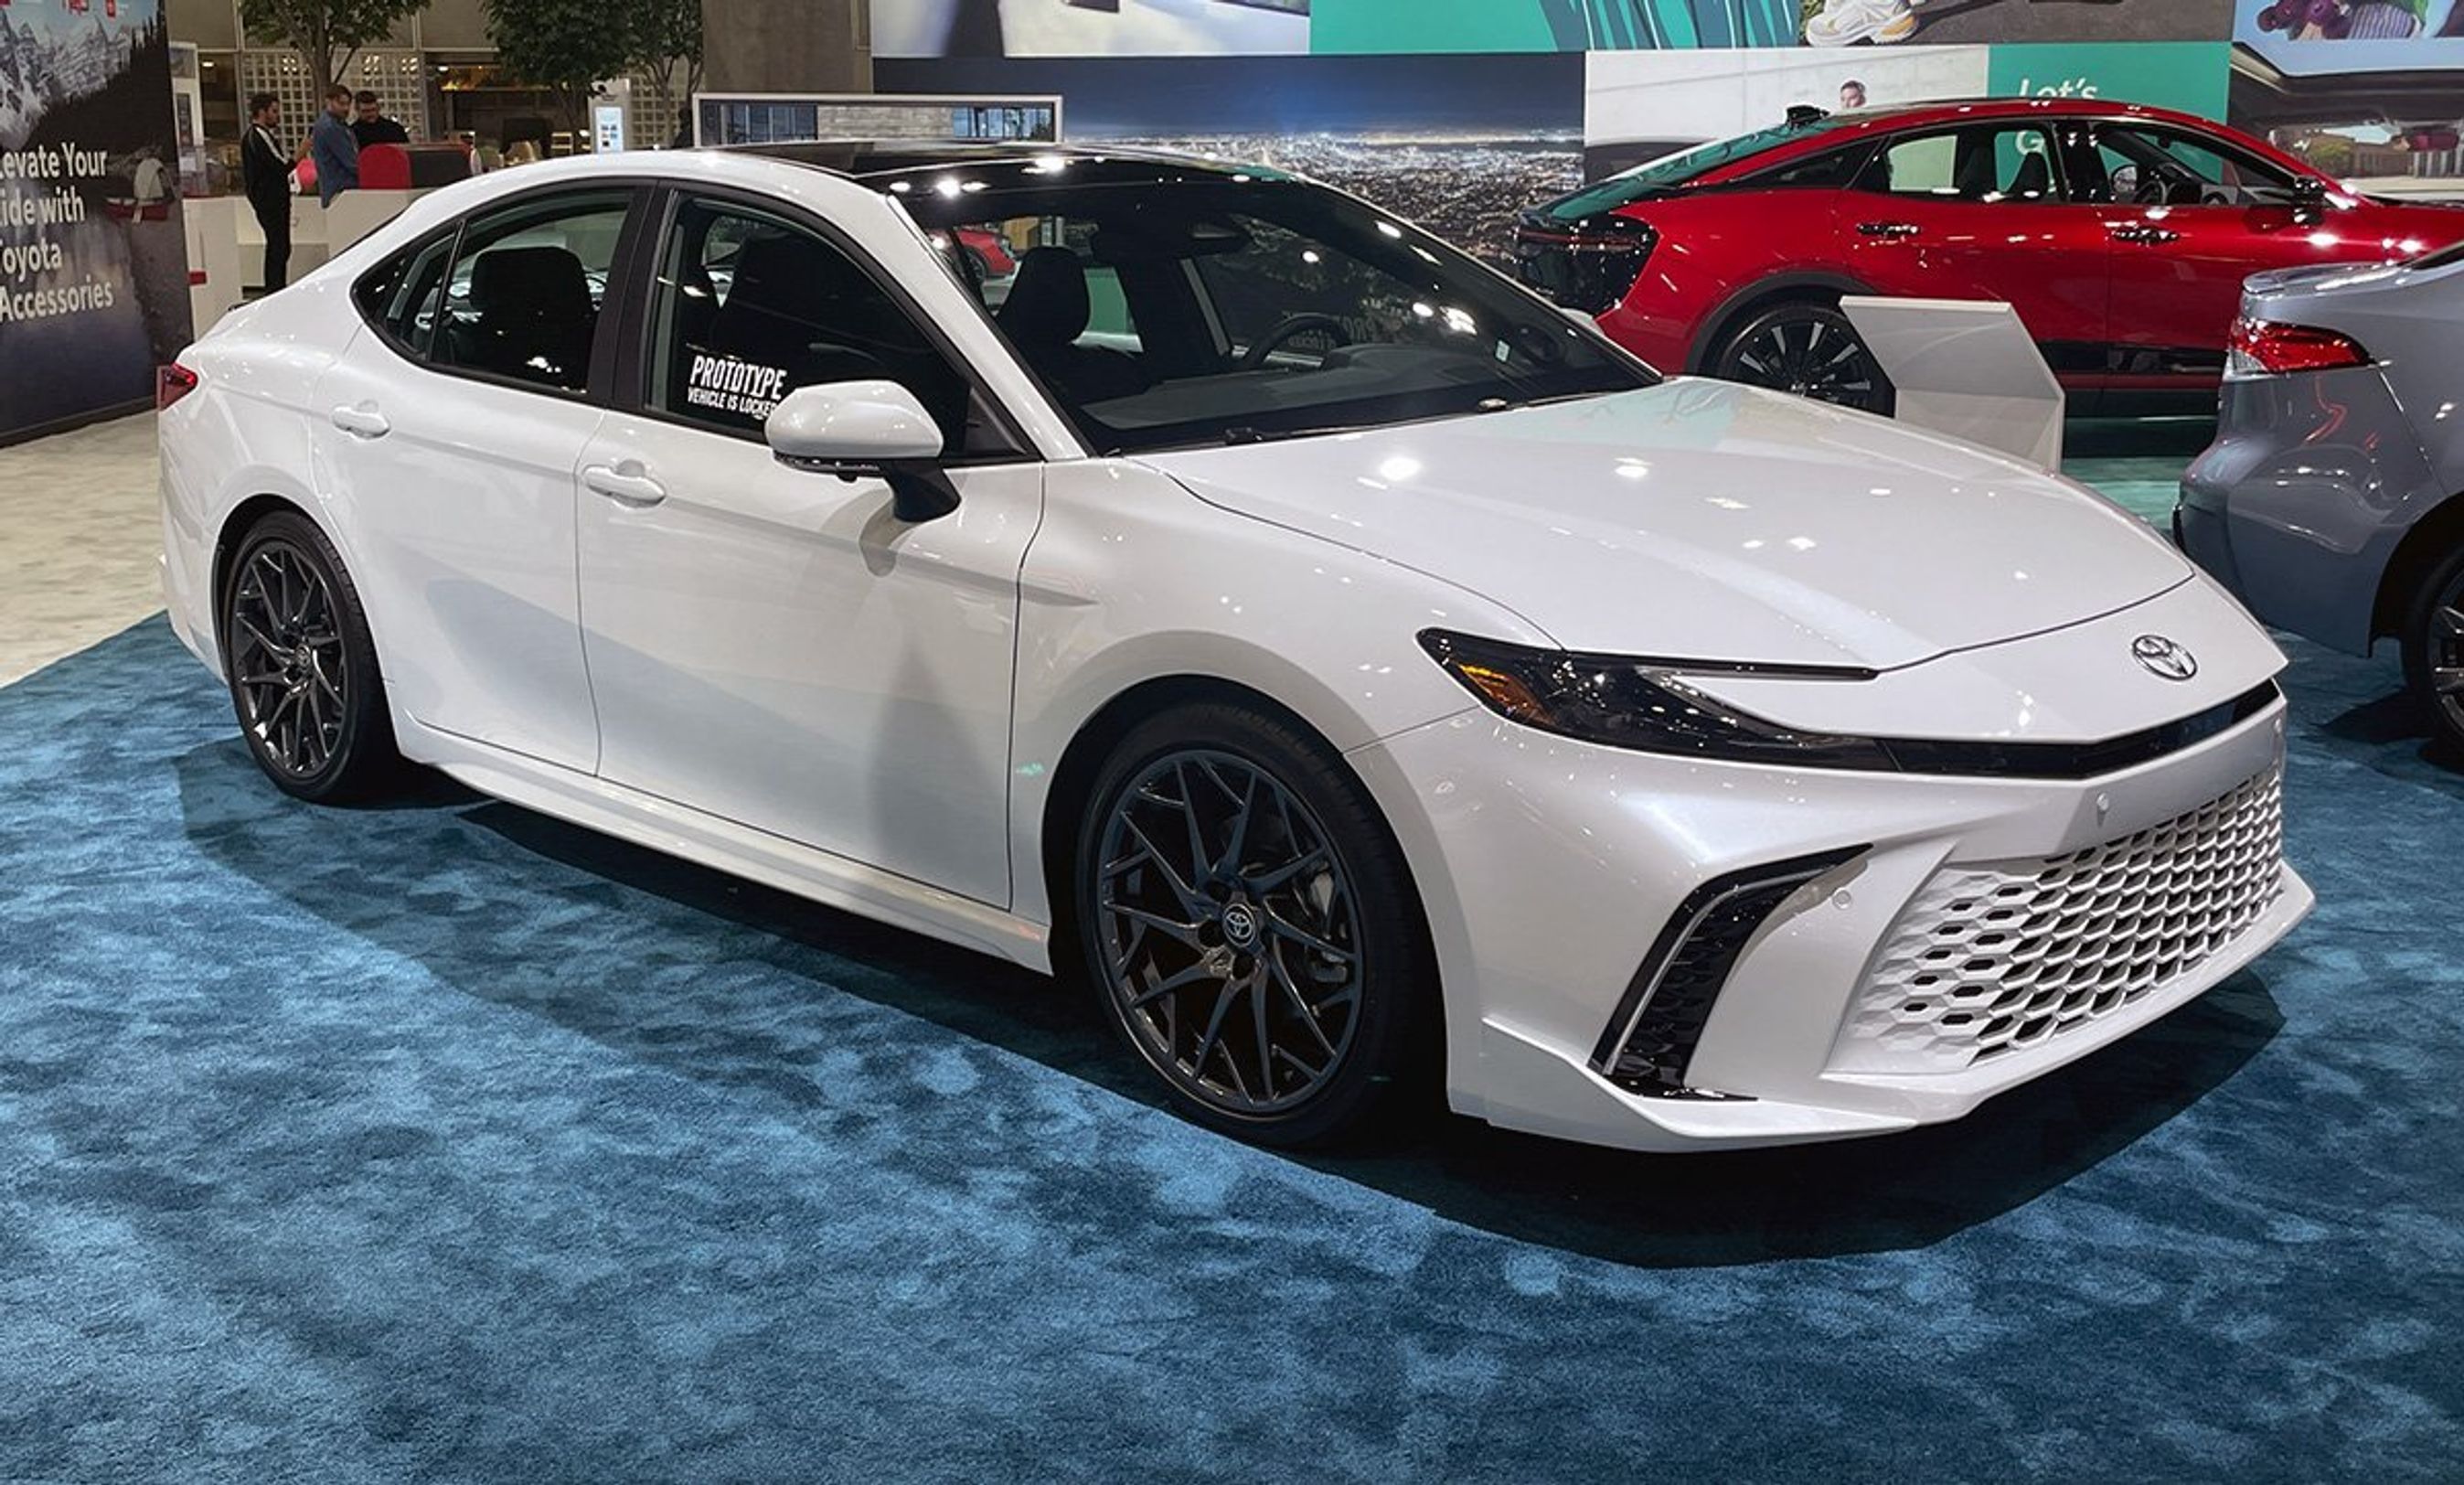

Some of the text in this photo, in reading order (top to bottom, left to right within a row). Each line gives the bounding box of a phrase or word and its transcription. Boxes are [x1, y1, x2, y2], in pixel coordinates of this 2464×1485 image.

[0, 142, 108, 179] evate Your
[0, 186, 85, 228] ide with
[0, 238, 62, 283] oyota
[0, 274, 114, 321] Accessories
[688, 386, 728, 409] VEHICLE
[727, 393, 739, 411] IS
[689, 355, 787, 401] PROTOTYPE
